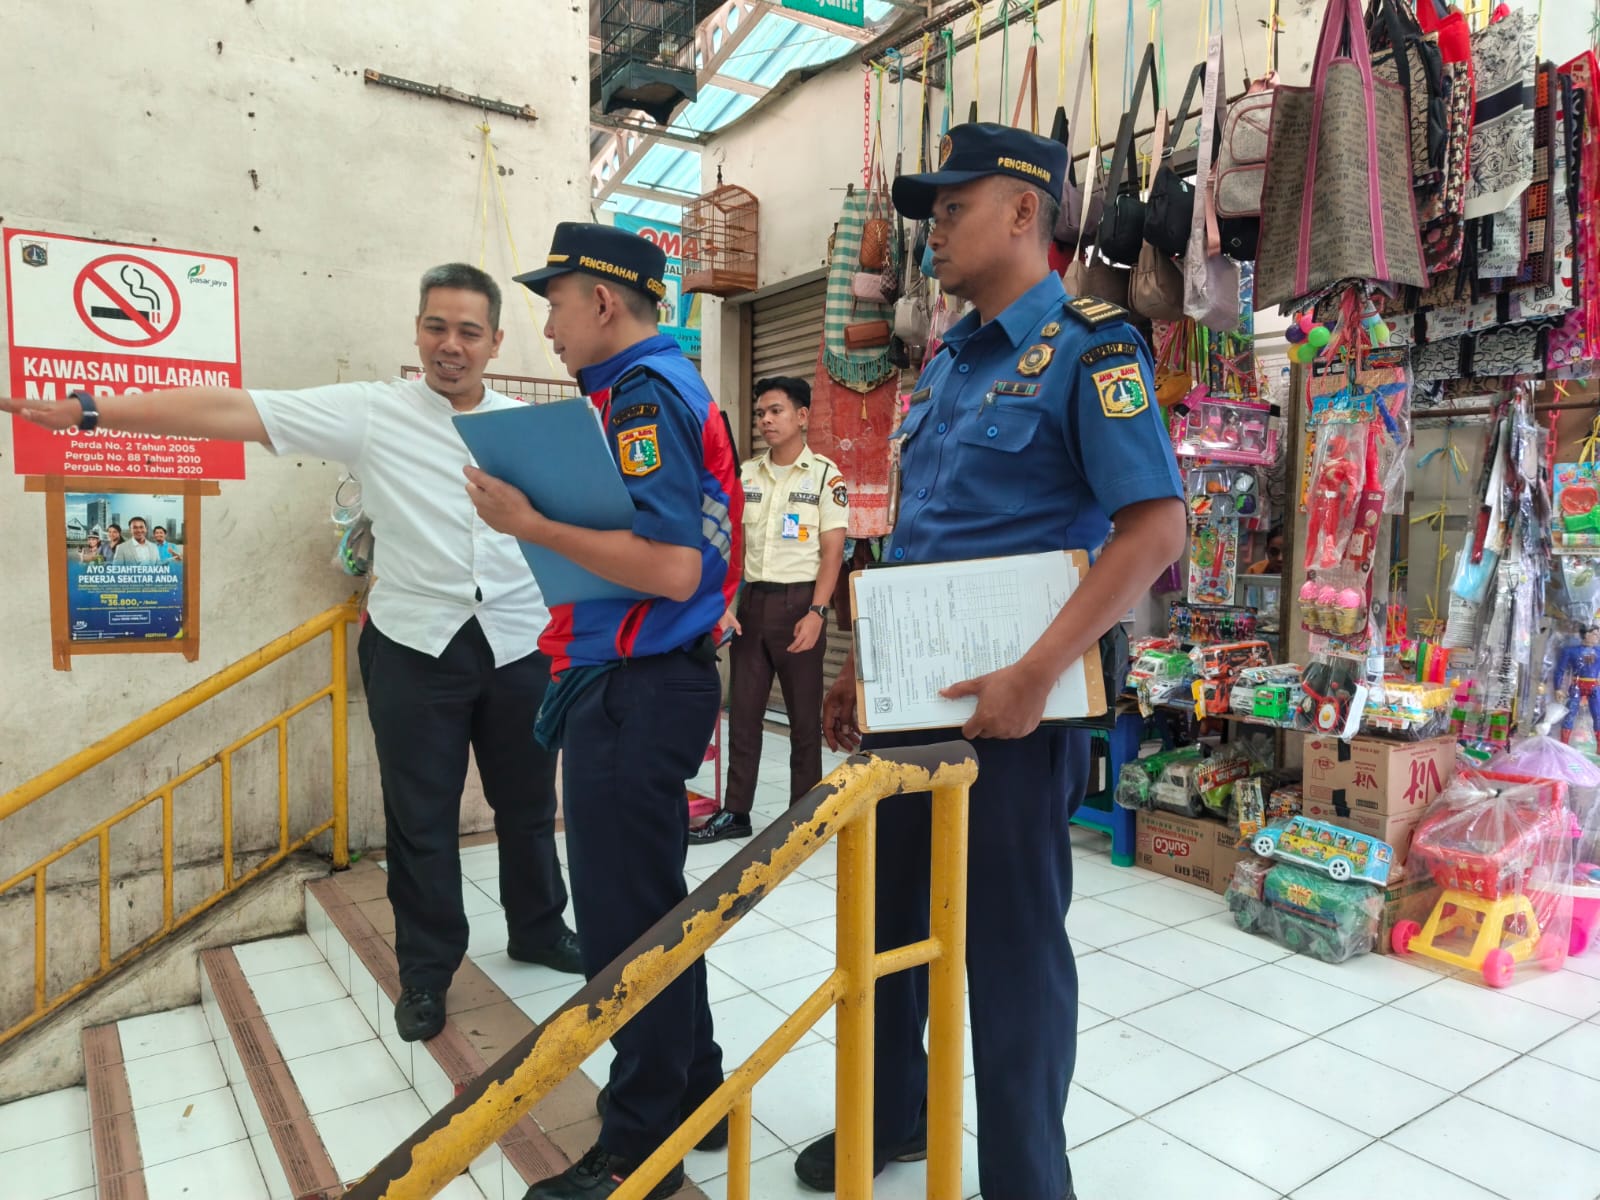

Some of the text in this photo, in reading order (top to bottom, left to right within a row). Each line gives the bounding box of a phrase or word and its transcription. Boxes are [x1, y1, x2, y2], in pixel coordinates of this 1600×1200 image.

[998, 157, 1051, 183] PENCEGAHAN
[579, 256, 639, 282] PENCEGAHAN
[210, 279, 227, 288] jaya
[23, 356, 230, 388] KAWASAN DILARANG
[71, 440, 196, 453] Perda No. 2 Tahun 2005
[65, 451, 201, 464] Pergub No. 88 Tahun 2010
[63, 462, 204, 474] Pergub No. 40 Tahun 2020
[86, 565, 170, 574] AYO SEJAHTERAKAN
[78, 574, 178, 584] PEKERJA SEKITAR ANDA
[1352, 771, 1378, 790] Vit
[1402, 758, 1441, 805] Vit
[1155, 838, 1188, 856] SunCo
